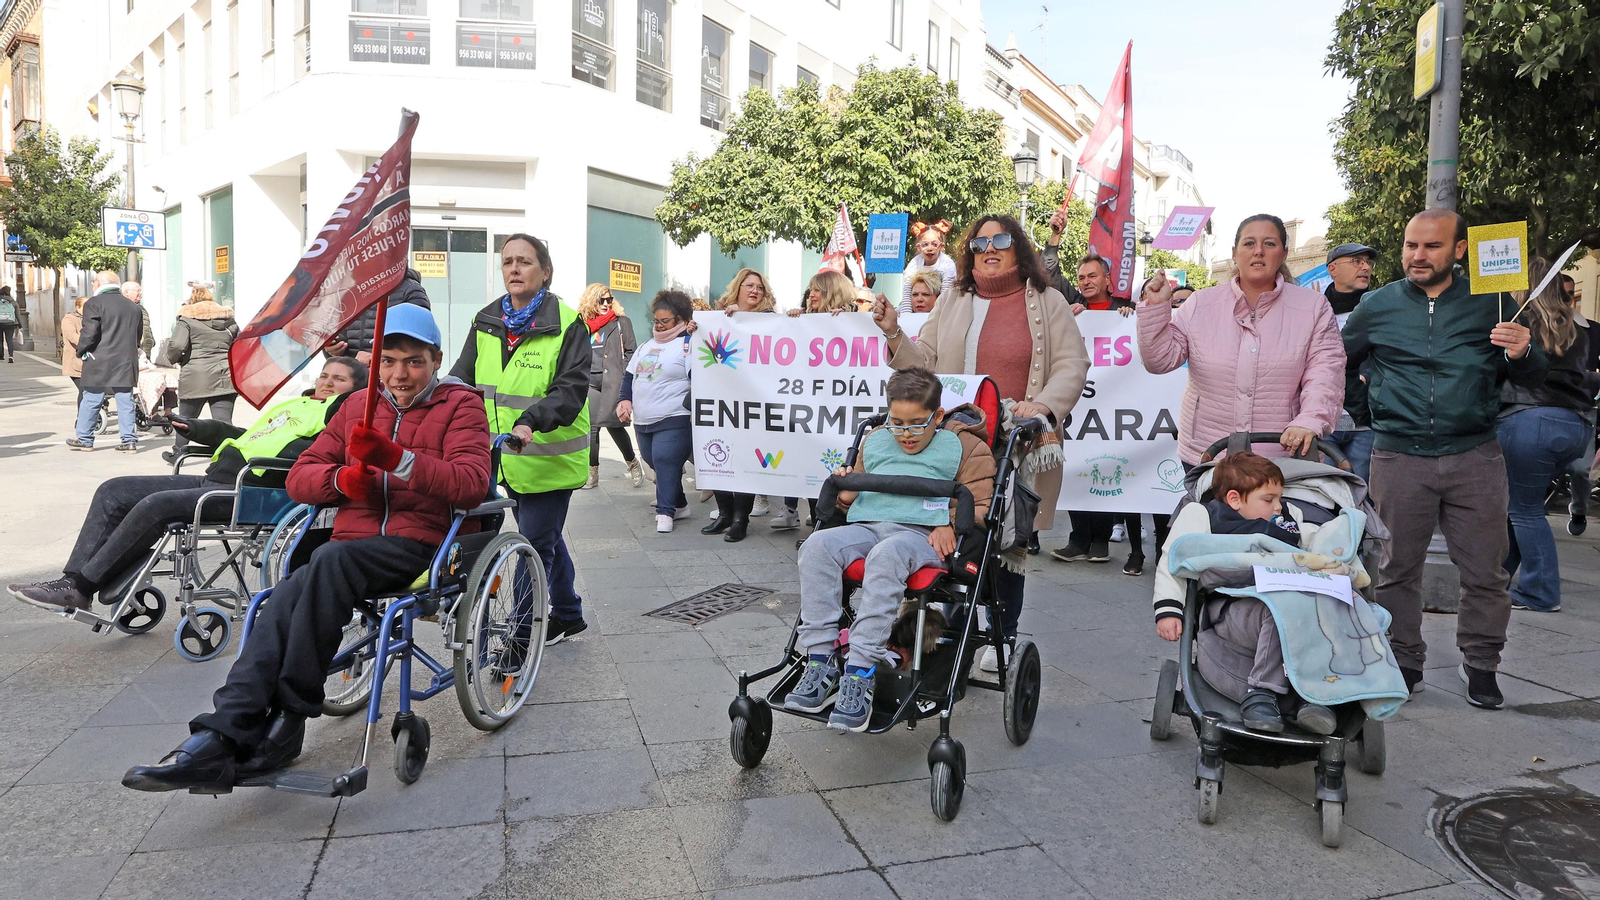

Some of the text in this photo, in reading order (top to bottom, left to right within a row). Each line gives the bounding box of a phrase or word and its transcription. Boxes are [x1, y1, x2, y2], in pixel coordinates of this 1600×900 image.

[353, 44, 387, 54] 956 33 00 68
[393, 46, 403, 55] 956
[404, 46, 411, 55] 34
[419, 47, 426, 56] 42
[459, 49, 492, 60] 956 33 00 68
[500, 51, 510, 60] 956
[511, 51, 518, 60] 34
[526, 52, 533, 61] 42
[1482, 258, 1519, 267] UNIPER
[621, 263, 638, 273] ALQUILA
[749, 334, 797, 366] NO
[808, 337, 888, 367] SOM
[777, 378, 804, 395] 28
[812, 380, 825, 396] F
[832, 375, 871, 396] DÍA
[1090, 487, 1123, 496] UNIPER
